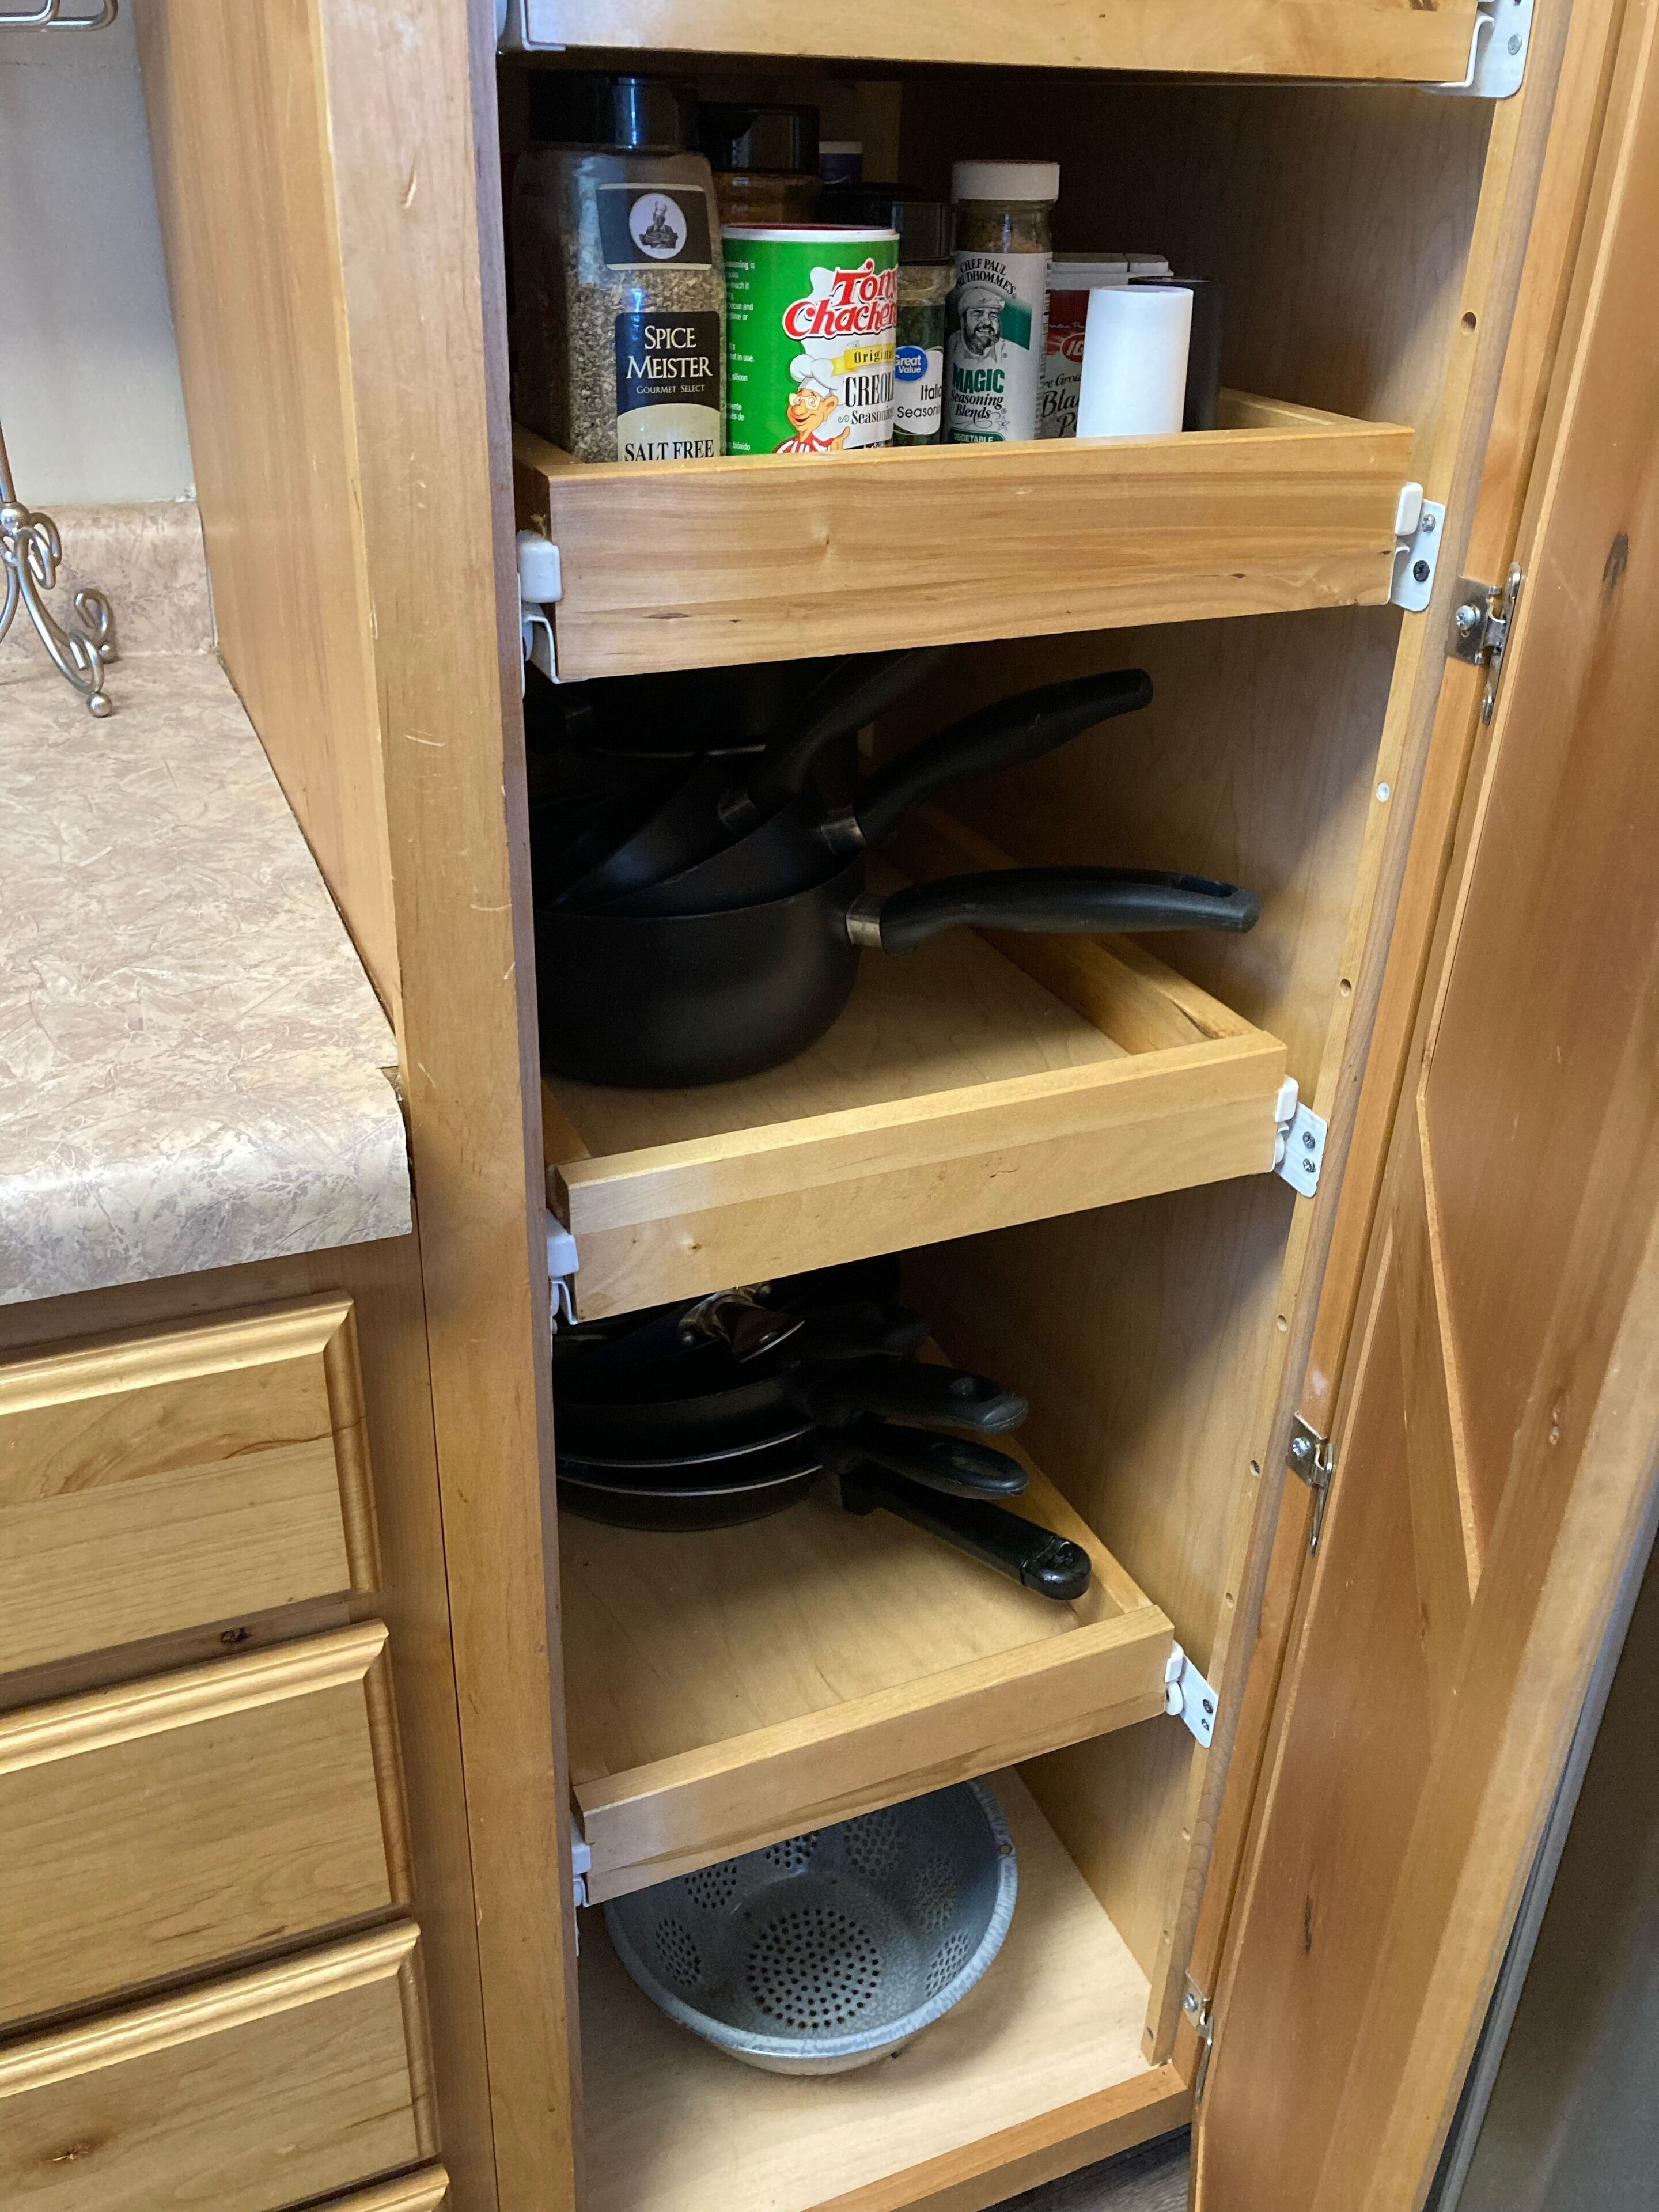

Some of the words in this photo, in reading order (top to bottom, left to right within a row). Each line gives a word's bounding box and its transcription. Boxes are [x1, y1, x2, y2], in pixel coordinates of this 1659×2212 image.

[960, 258, 982, 274] CHEF
[984, 258, 1006, 276] PAUL
[644, 325, 696, 350] SPICE
[1066, 340, 1084, 356] IG
[626, 355, 713, 380] MEISTER
[896, 355, 922, 366] Great
[899, 366, 921, 374] Value
[952, 363, 1005, 394] MAGIC
[637, 385, 676, 395] GOURMET
[680, 384, 705, 393] SELECT
[950, 389, 1004, 410] Seasoning
[1043, 388, 1079, 418] Bla
[955, 404, 991, 425] Blends
[953, 433, 994, 442] VEGETABLE
[624, 442, 669, 461] SALT
[672, 439, 714, 459] FREE
